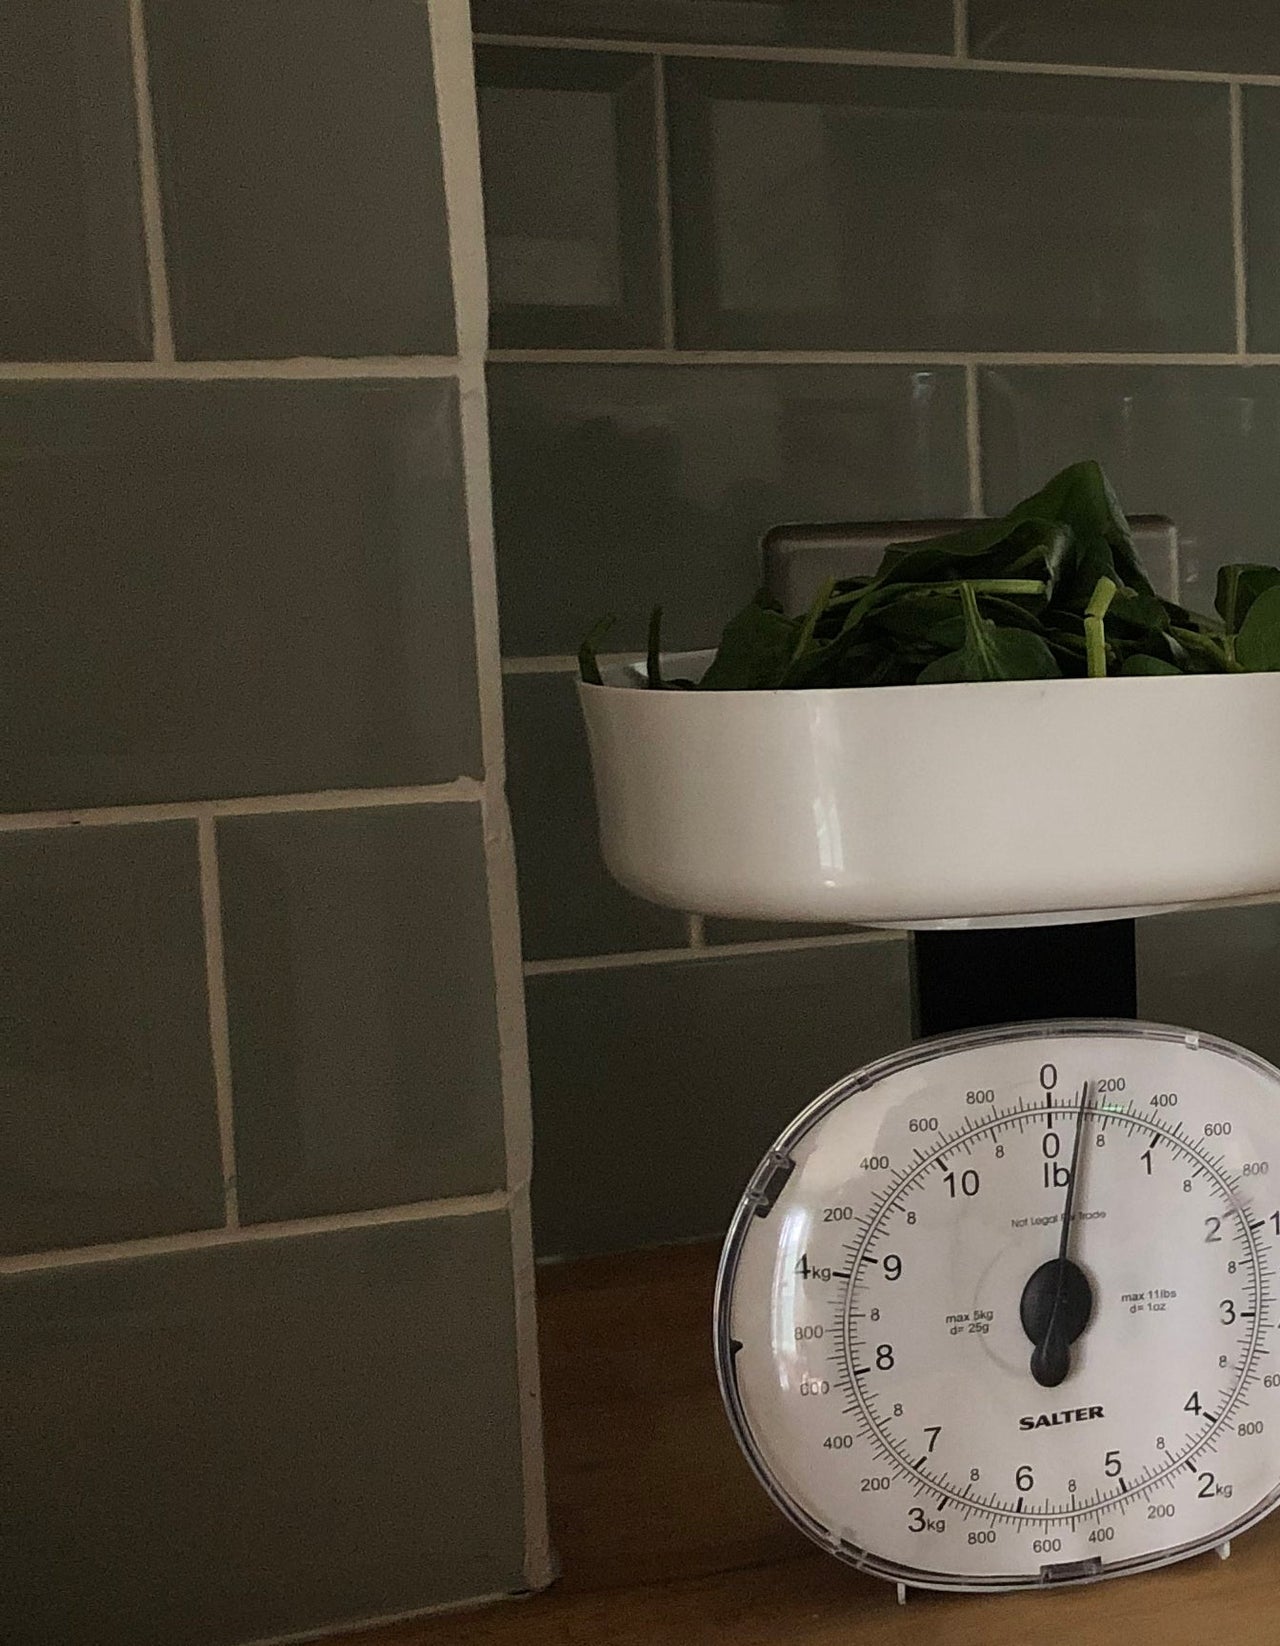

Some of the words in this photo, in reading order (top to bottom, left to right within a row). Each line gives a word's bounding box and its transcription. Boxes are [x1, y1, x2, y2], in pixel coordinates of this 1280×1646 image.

[1040, 1063, 1058, 1090] 0
[1097, 1077, 1126, 1093] 200
[966, 1090, 995, 1105] 800
[1150, 1093, 1178, 1108] 400
[909, 1117, 939, 1132] 600
[1204, 1122, 1232, 1137] 600
[1042, 1132, 1060, 1159] 0
[1096, 1134, 1105, 1148] 8
[995, 1145, 1004, 1159] 8
[859, 1155, 890, 1170] 400
[1140, 1150, 1152, 1175] 1
[1242, 1162, 1269, 1176] 800
[1043, 1162, 1071, 1188] lb
[943, 1170, 980, 1198] 10
[1182, 1179, 1192, 1193] 8
[823, 1206, 853, 1222] 200
[907, 1211, 917, 1225] 8
[1060, 1213, 1076, 1222] Fr
[1204, 1216, 1222, 1243] 2
[794, 1253, 832, 1281] 4kg
[883, 1254, 902, 1281] 9
[1227, 1260, 1237, 1274] 8
[1121, 1292, 1145, 1303] max
[870, 1308, 880, 1322] 8
[945, 1313, 970, 1325] max
[1219, 1299, 1236, 1325] 3
[794, 1324, 824, 1340] 800
[876, 1344, 895, 1371] 8
[1218, 1355, 1227, 1368] 8
[893, 1403, 903, 1417] 8
[1183, 1391, 1202, 1416] 4
[1018, 1405, 1105, 1431] SALTER
[1237, 1421, 1264, 1436] 800
[822, 1435, 853, 1449] 400
[923, 1426, 942, 1452] 7
[1156, 1436, 1165, 1450] 8
[1104, 1450, 1122, 1477] 5
[970, 1468, 980, 1482] 8
[1015, 1465, 1034, 1491] 6
[860, 1477, 890, 1492] 200
[1068, 1479, 1077, 1493] 8
[1197, 1472, 1233, 1499] 2kg
[1147, 1504, 1175, 1519] 200
[907, 1507, 946, 1533] 3kg
[967, 1530, 996, 1545] 800
[1088, 1527, 1115, 1543] 400
[1032, 1538, 1061, 1553] 600
